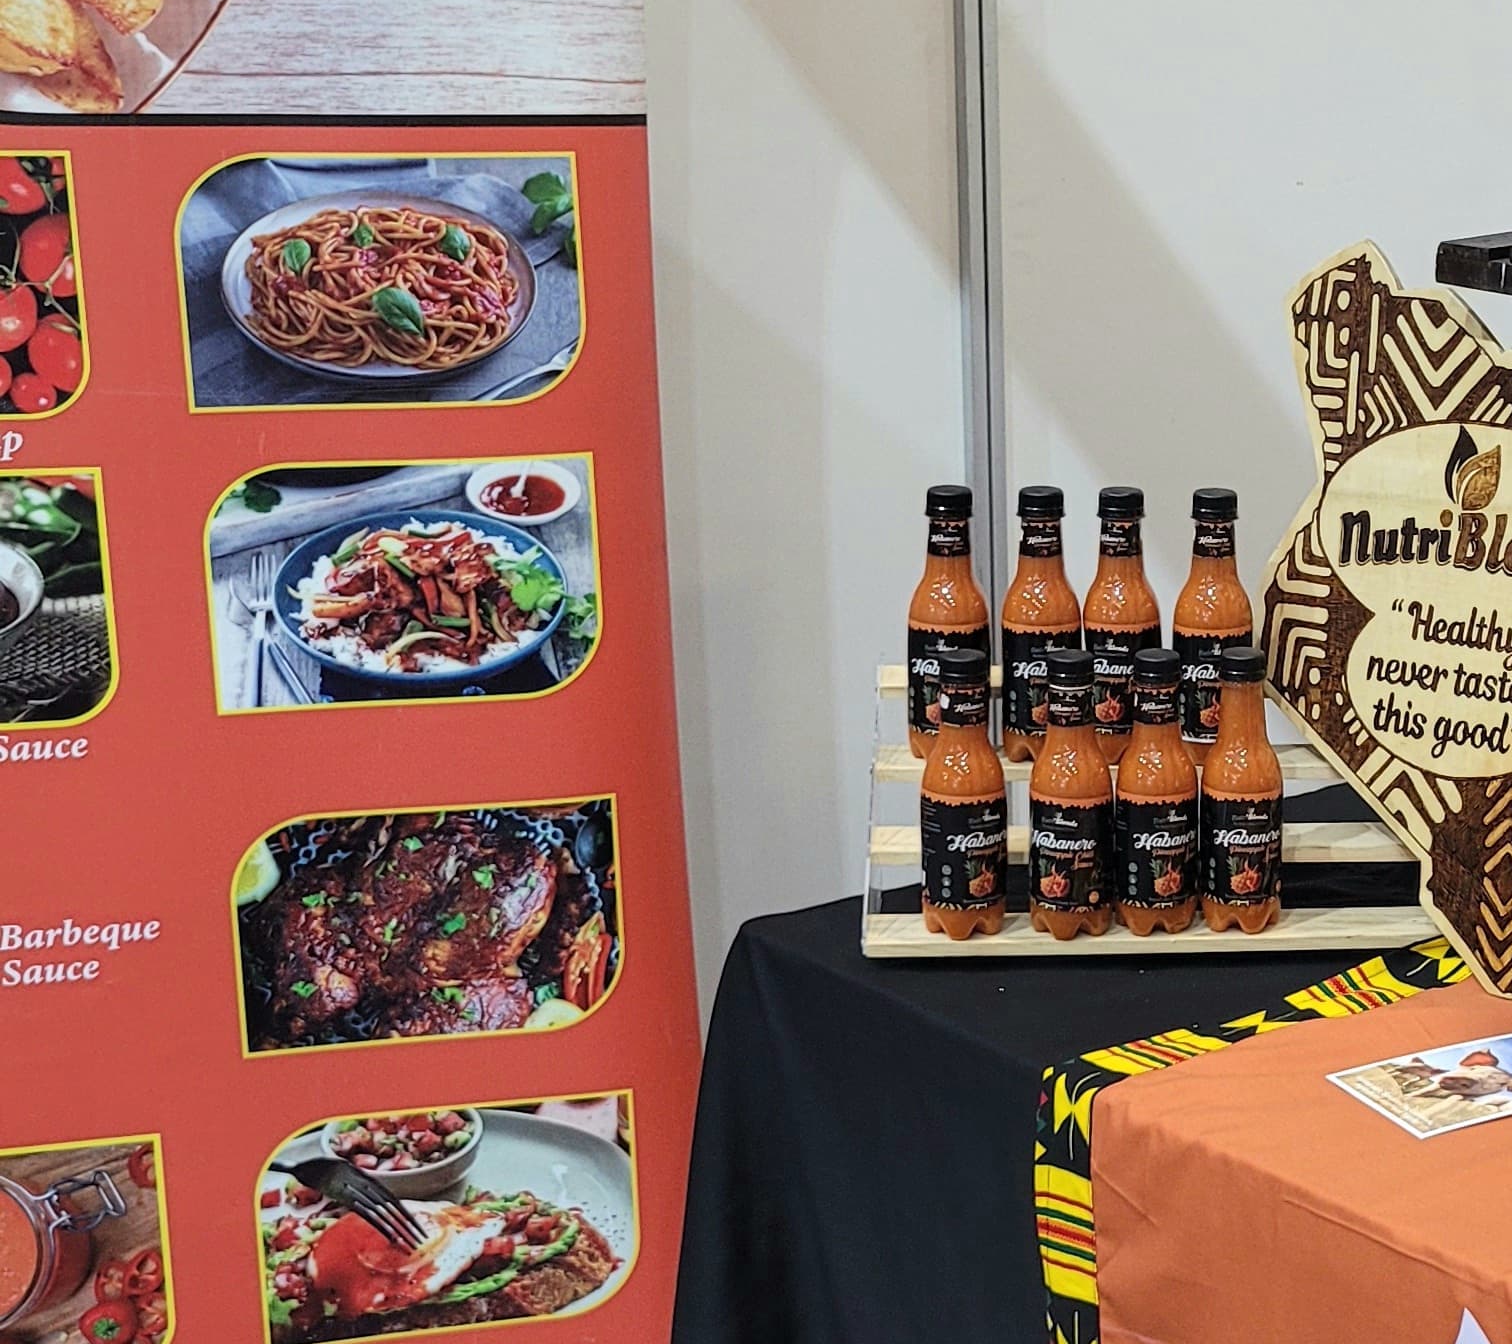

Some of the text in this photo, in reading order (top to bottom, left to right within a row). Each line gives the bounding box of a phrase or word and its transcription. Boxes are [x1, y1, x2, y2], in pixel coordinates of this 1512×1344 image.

[1093, 658, 1135, 675] abane
[1366, 655, 1449, 692] never
[1373, 692, 1427, 739] this
[0, 919, 160, 950] Barbeque
[2, 960, 99, 986] Sauce
